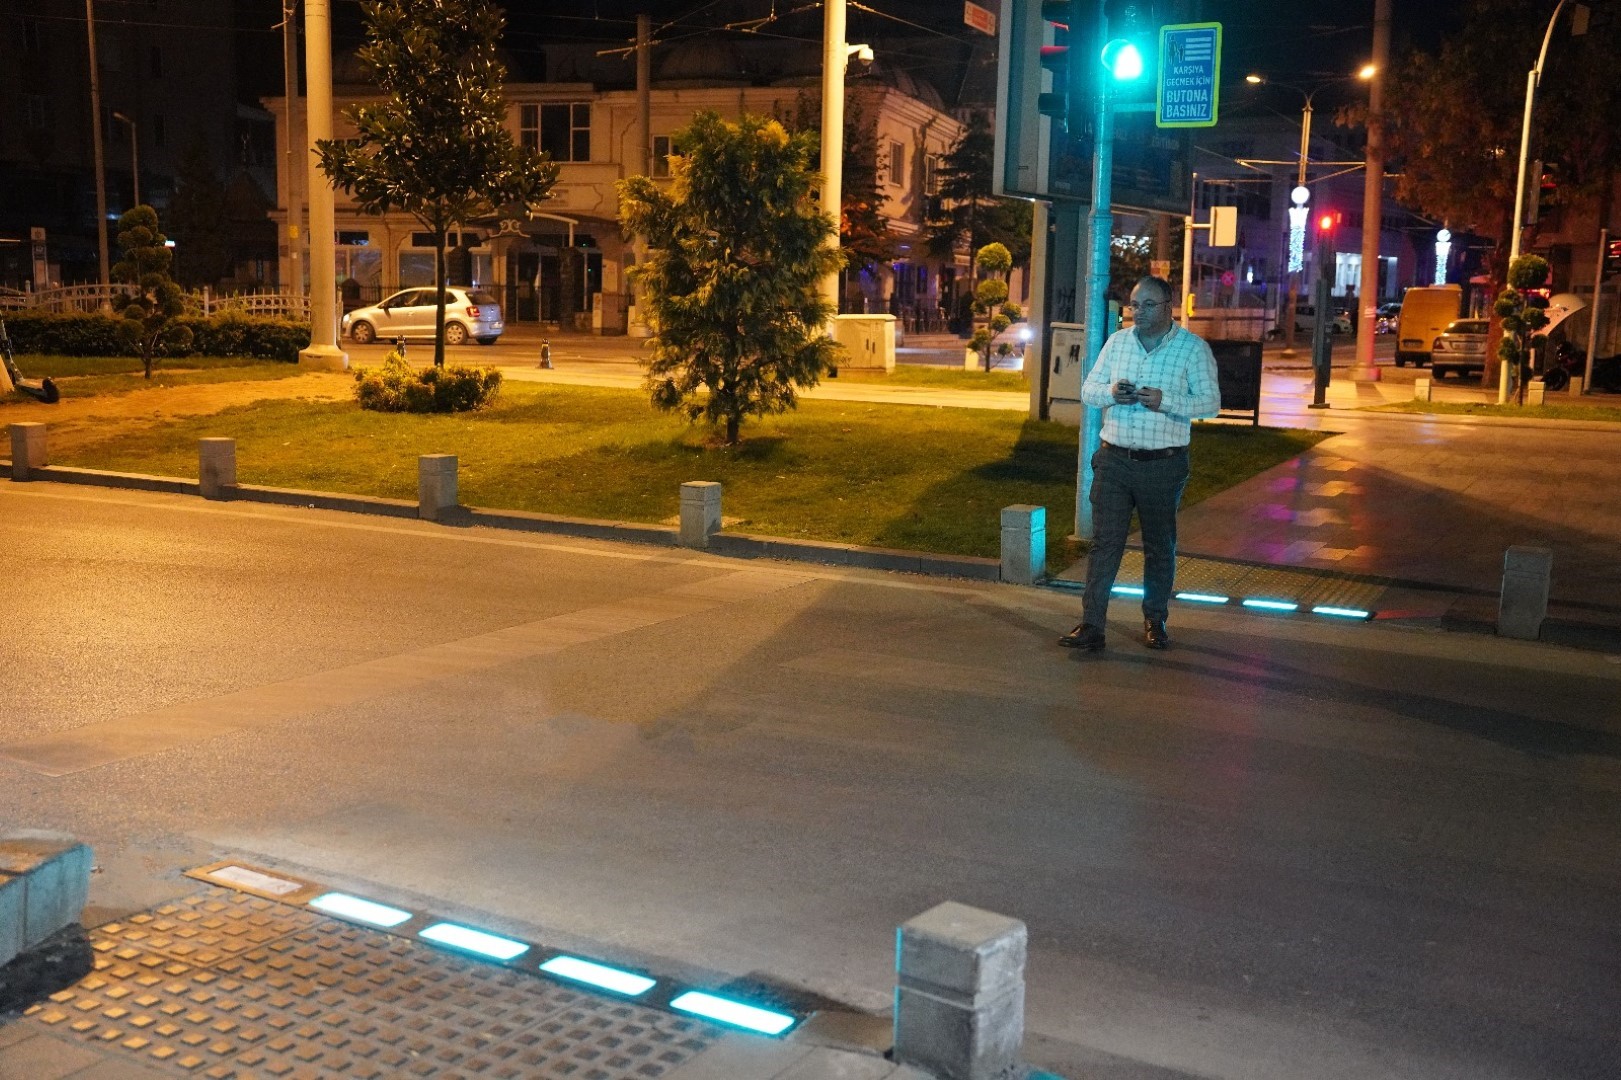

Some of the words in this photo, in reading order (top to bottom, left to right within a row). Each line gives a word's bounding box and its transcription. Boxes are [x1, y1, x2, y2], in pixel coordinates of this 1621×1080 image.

[1173, 65, 1204, 75] KARŞIYA
[1166, 89, 1208, 102] BUTONA
[1166, 103, 1207, 117] BASINIZ
